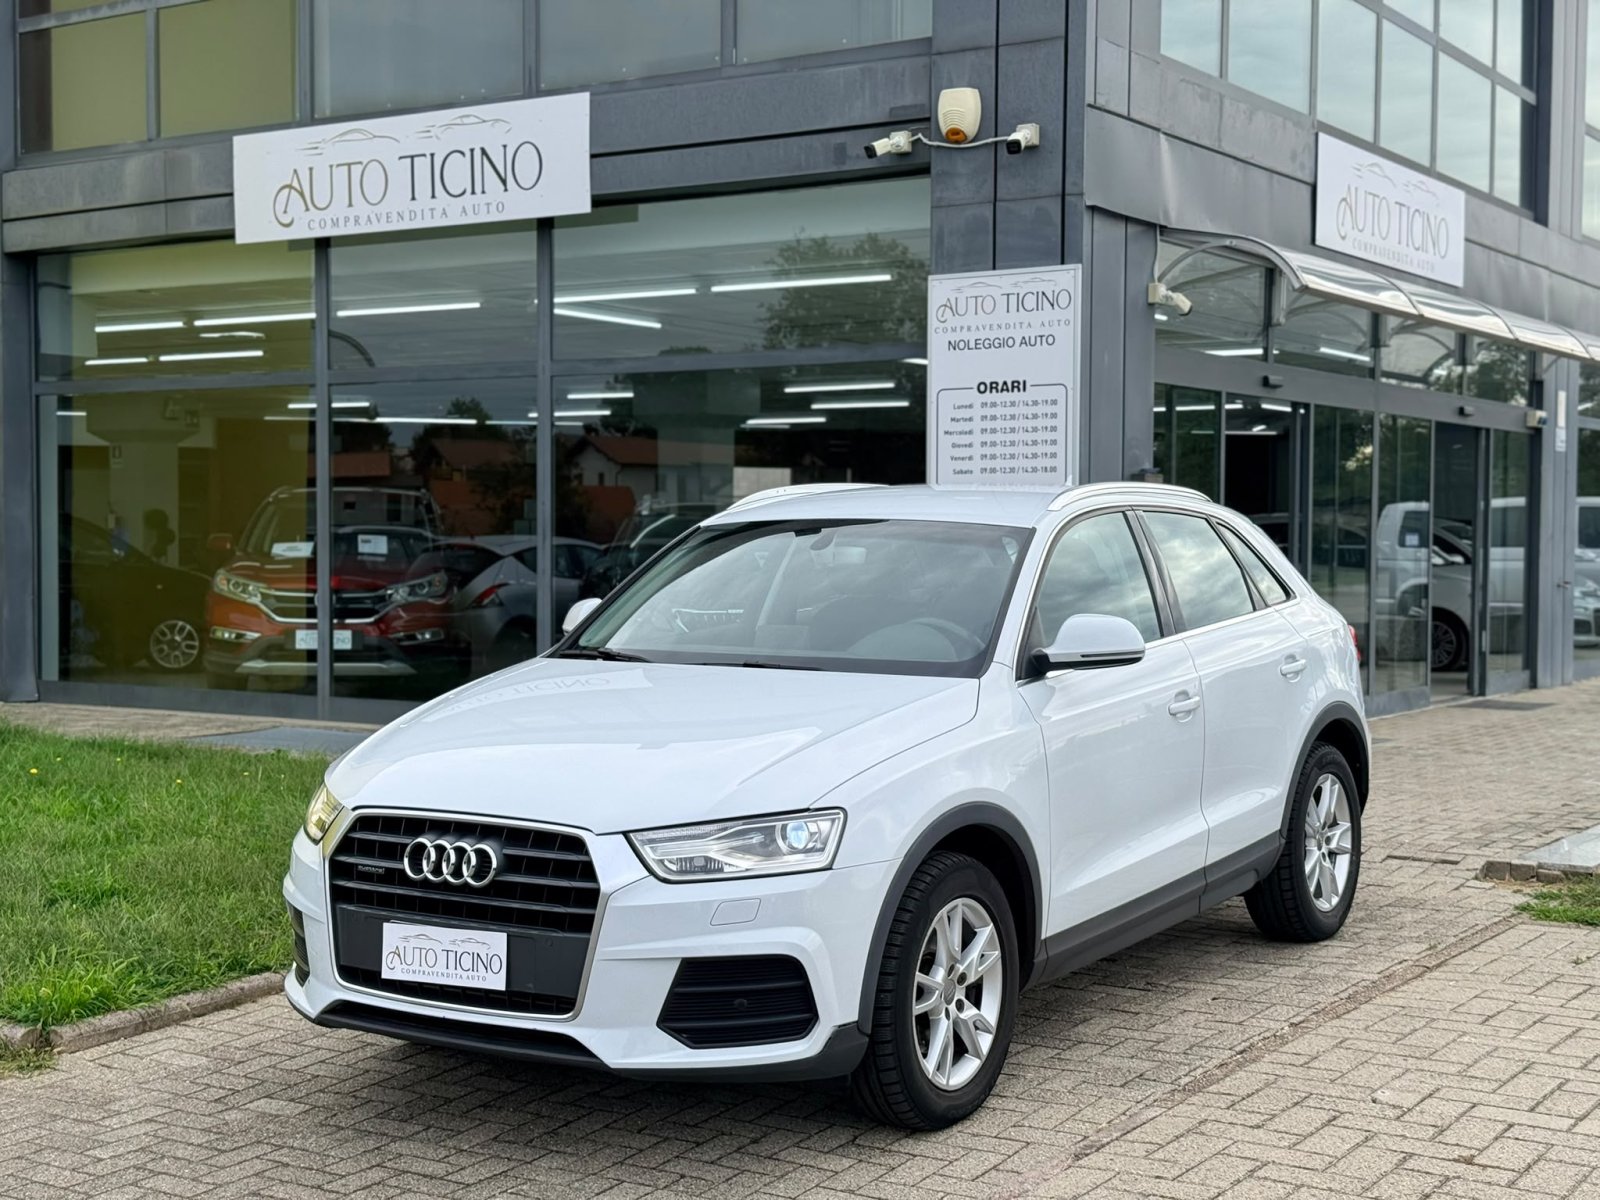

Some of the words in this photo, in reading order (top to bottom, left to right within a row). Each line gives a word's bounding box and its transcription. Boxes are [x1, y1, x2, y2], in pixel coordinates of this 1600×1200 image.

[273, 158, 388, 228] AUTO
[398, 141, 543, 201] TICINO
[307, 207, 449, 231] COMPRAVENDITA
[460, 201, 506, 217] AUTO
[1336, 184, 1391, 241] AUTO
[1394, 201, 1449, 259] TICINO
[936, 294, 996, 323] AUTO
[1001, 289, 1072, 314] TICINO
[934, 321, 1032, 335] COMPRAVENDITA
[1040, 319, 1071, 327] AUTO
[948, 336, 1016, 352] NOLEGGIO
[1019, 334, 1056, 348] AUTO
[977, 380, 1027, 394] ORARI
[385, 945, 438, 971] AUTO
[441, 949, 503, 975] TICINO
[401, 968, 463, 980] COMPRAVENDITA
[465, 973, 487, 982] AUTO
